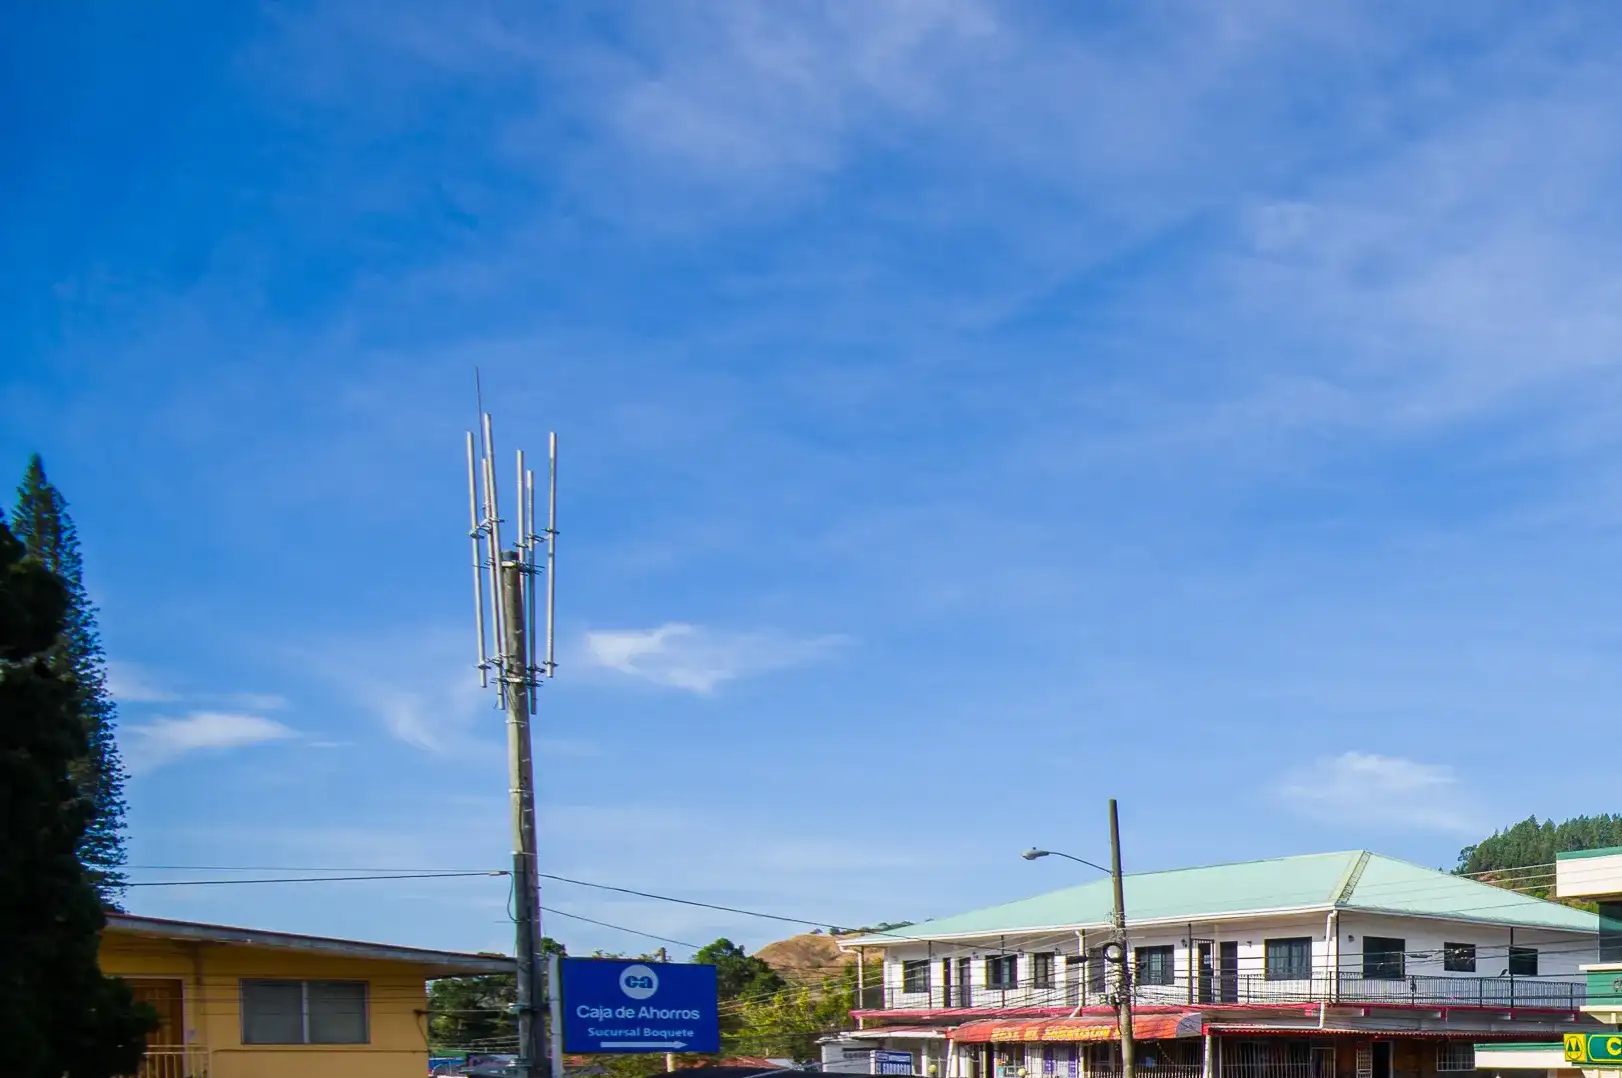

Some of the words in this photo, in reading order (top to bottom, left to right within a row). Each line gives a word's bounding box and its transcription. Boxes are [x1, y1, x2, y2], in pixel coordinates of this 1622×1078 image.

[576, 1005, 614, 1022] Caja
[615, 1006, 636, 1019] de
[638, 1006, 700, 1020] Ahorros
[587, 1027, 640, 1038] Sucursal
[643, 1027, 695, 1039] Boquete
